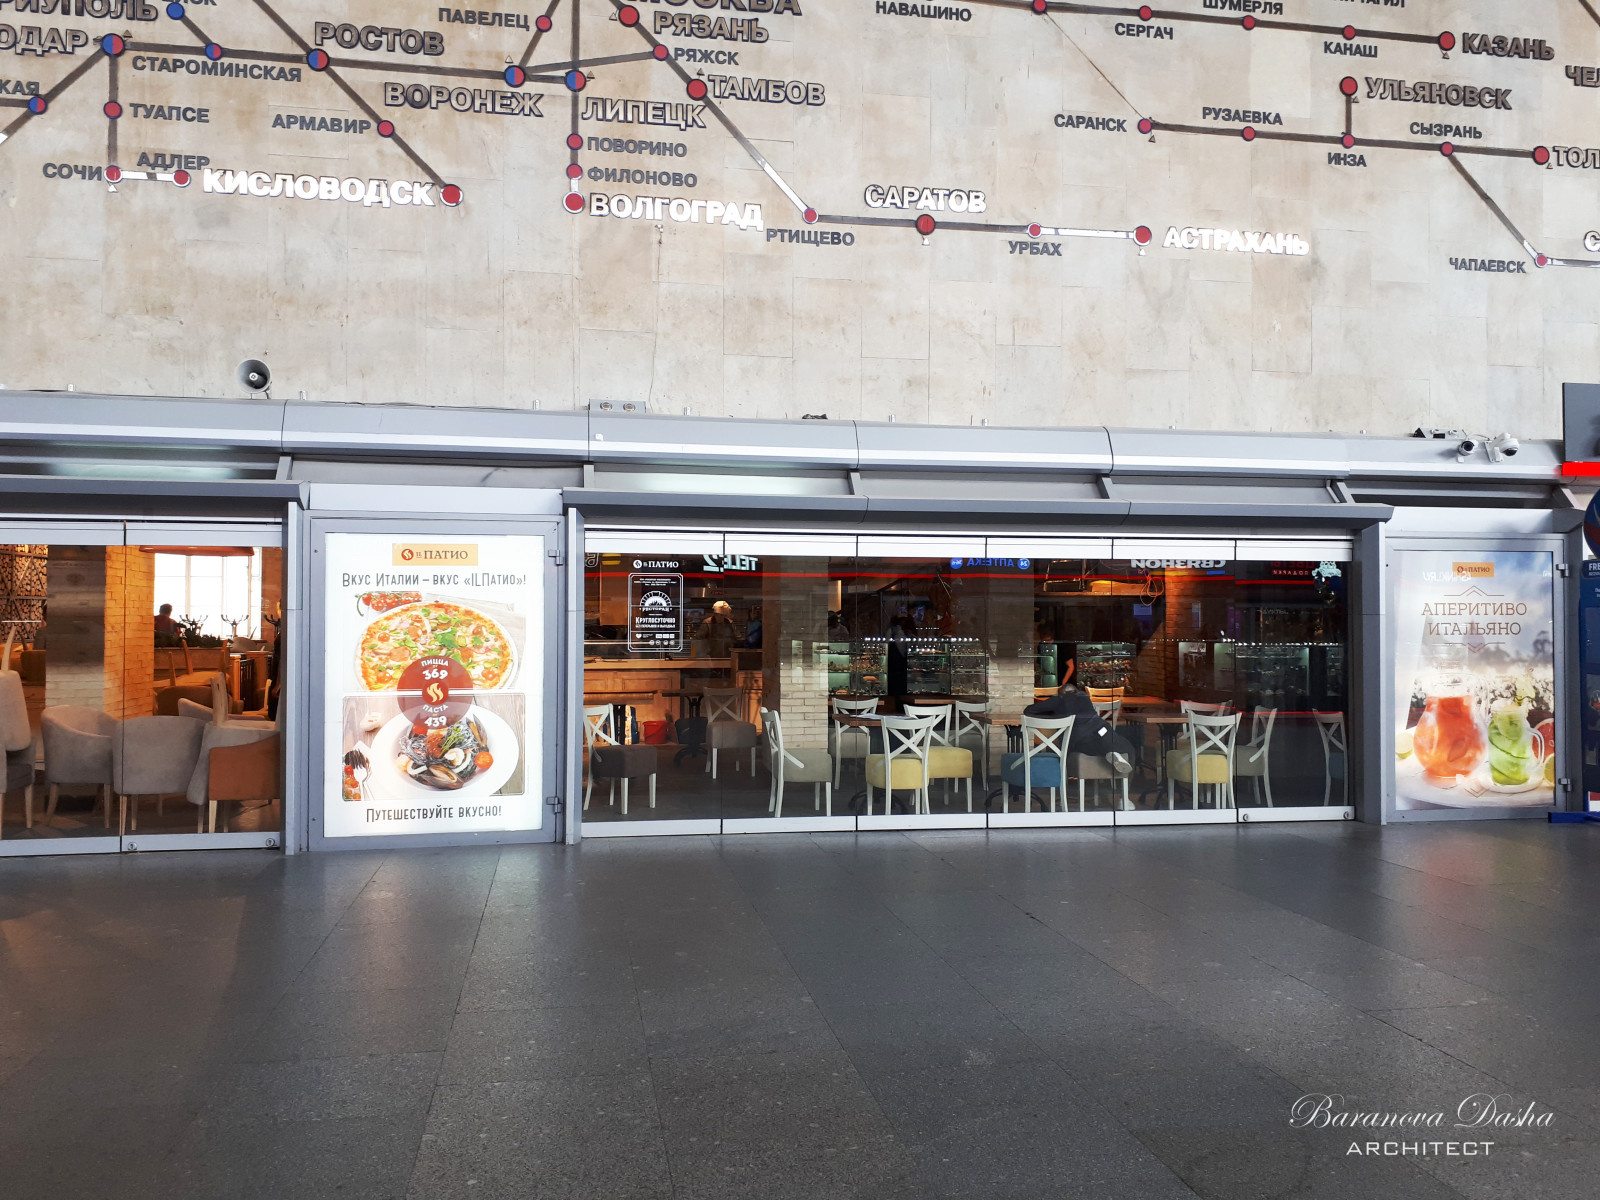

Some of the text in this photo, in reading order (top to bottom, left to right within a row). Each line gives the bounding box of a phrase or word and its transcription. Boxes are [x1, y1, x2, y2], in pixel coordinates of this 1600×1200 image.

[875, 0, 972, 22] НАВАШИНО
[1203, 0, 1283, 15] ШУМЕРЛЯ
[438, 7, 530, 31] ПАВЕЛЕЦ
[654, 11, 769, 43] РЯЗАНЬ
[314, 22, 445, 55] РОСТОВ
[1115, 22, 1174, 40] СЕРГАЧ
[1323, 41, 1378, 58] КАНАШ
[1462, 33, 1555, 60] КАЗАНЬ
[674, 47, 739, 66] РЯЖСК
[132, 55, 302, 83] СТАРОМИНСКАЯ
[708, 74, 825, 106] ТАМБОВ
[1365, 77, 1512, 110] УЛЬЯНОВСК
[384, 83, 543, 118] ВОРОНЕЖ
[130, 103, 210, 123] ТУАПСЕ
[582, 98, 706, 131] ЛИПЕЦК
[1202, 106, 1283, 126] РУЗАЕВКА
[272, 114, 372, 134] АРМАВИР
[1054, 114, 1127, 132] САРАНСК
[1410, 122, 1483, 139] СЫЗРАНЬ
[587, 137, 687, 158] ПОВОРИНО
[137, 152, 210, 170] АДЛЕР
[1327, 152, 1367, 168] ИНЗА
[43, 163, 102, 181] СОЧИ
[587, 166, 697, 188] ФИЛОНОВО
[203, 168, 435, 207] КИСЛОВОДСК
[864, 184, 987, 214] САРАТОВ
[589, 194, 763, 231] ВОЛГОГРАД
[766, 228, 855, 247] РТИЩЕВО
[1163, 225, 1310, 256] АСТРАХАНЬ
[1009, 240, 1062, 256] УРБАХ
[1450, 258, 1526, 274] ЧАПАЕВСК
[424, 550, 468, 559] ПАТИО
[648, 560, 679, 569] ПАТИО
[1421, 602, 1527, 616] АПЕРИТИВО
[1428, 622, 1521, 636] ИТАЛЬЯНО
[421, 658, 449, 667] ПИЦЦА
[422, 668, 449, 680] 369
[422, 704, 449, 713] ПАСТА
[424, 715, 447, 727] 439
